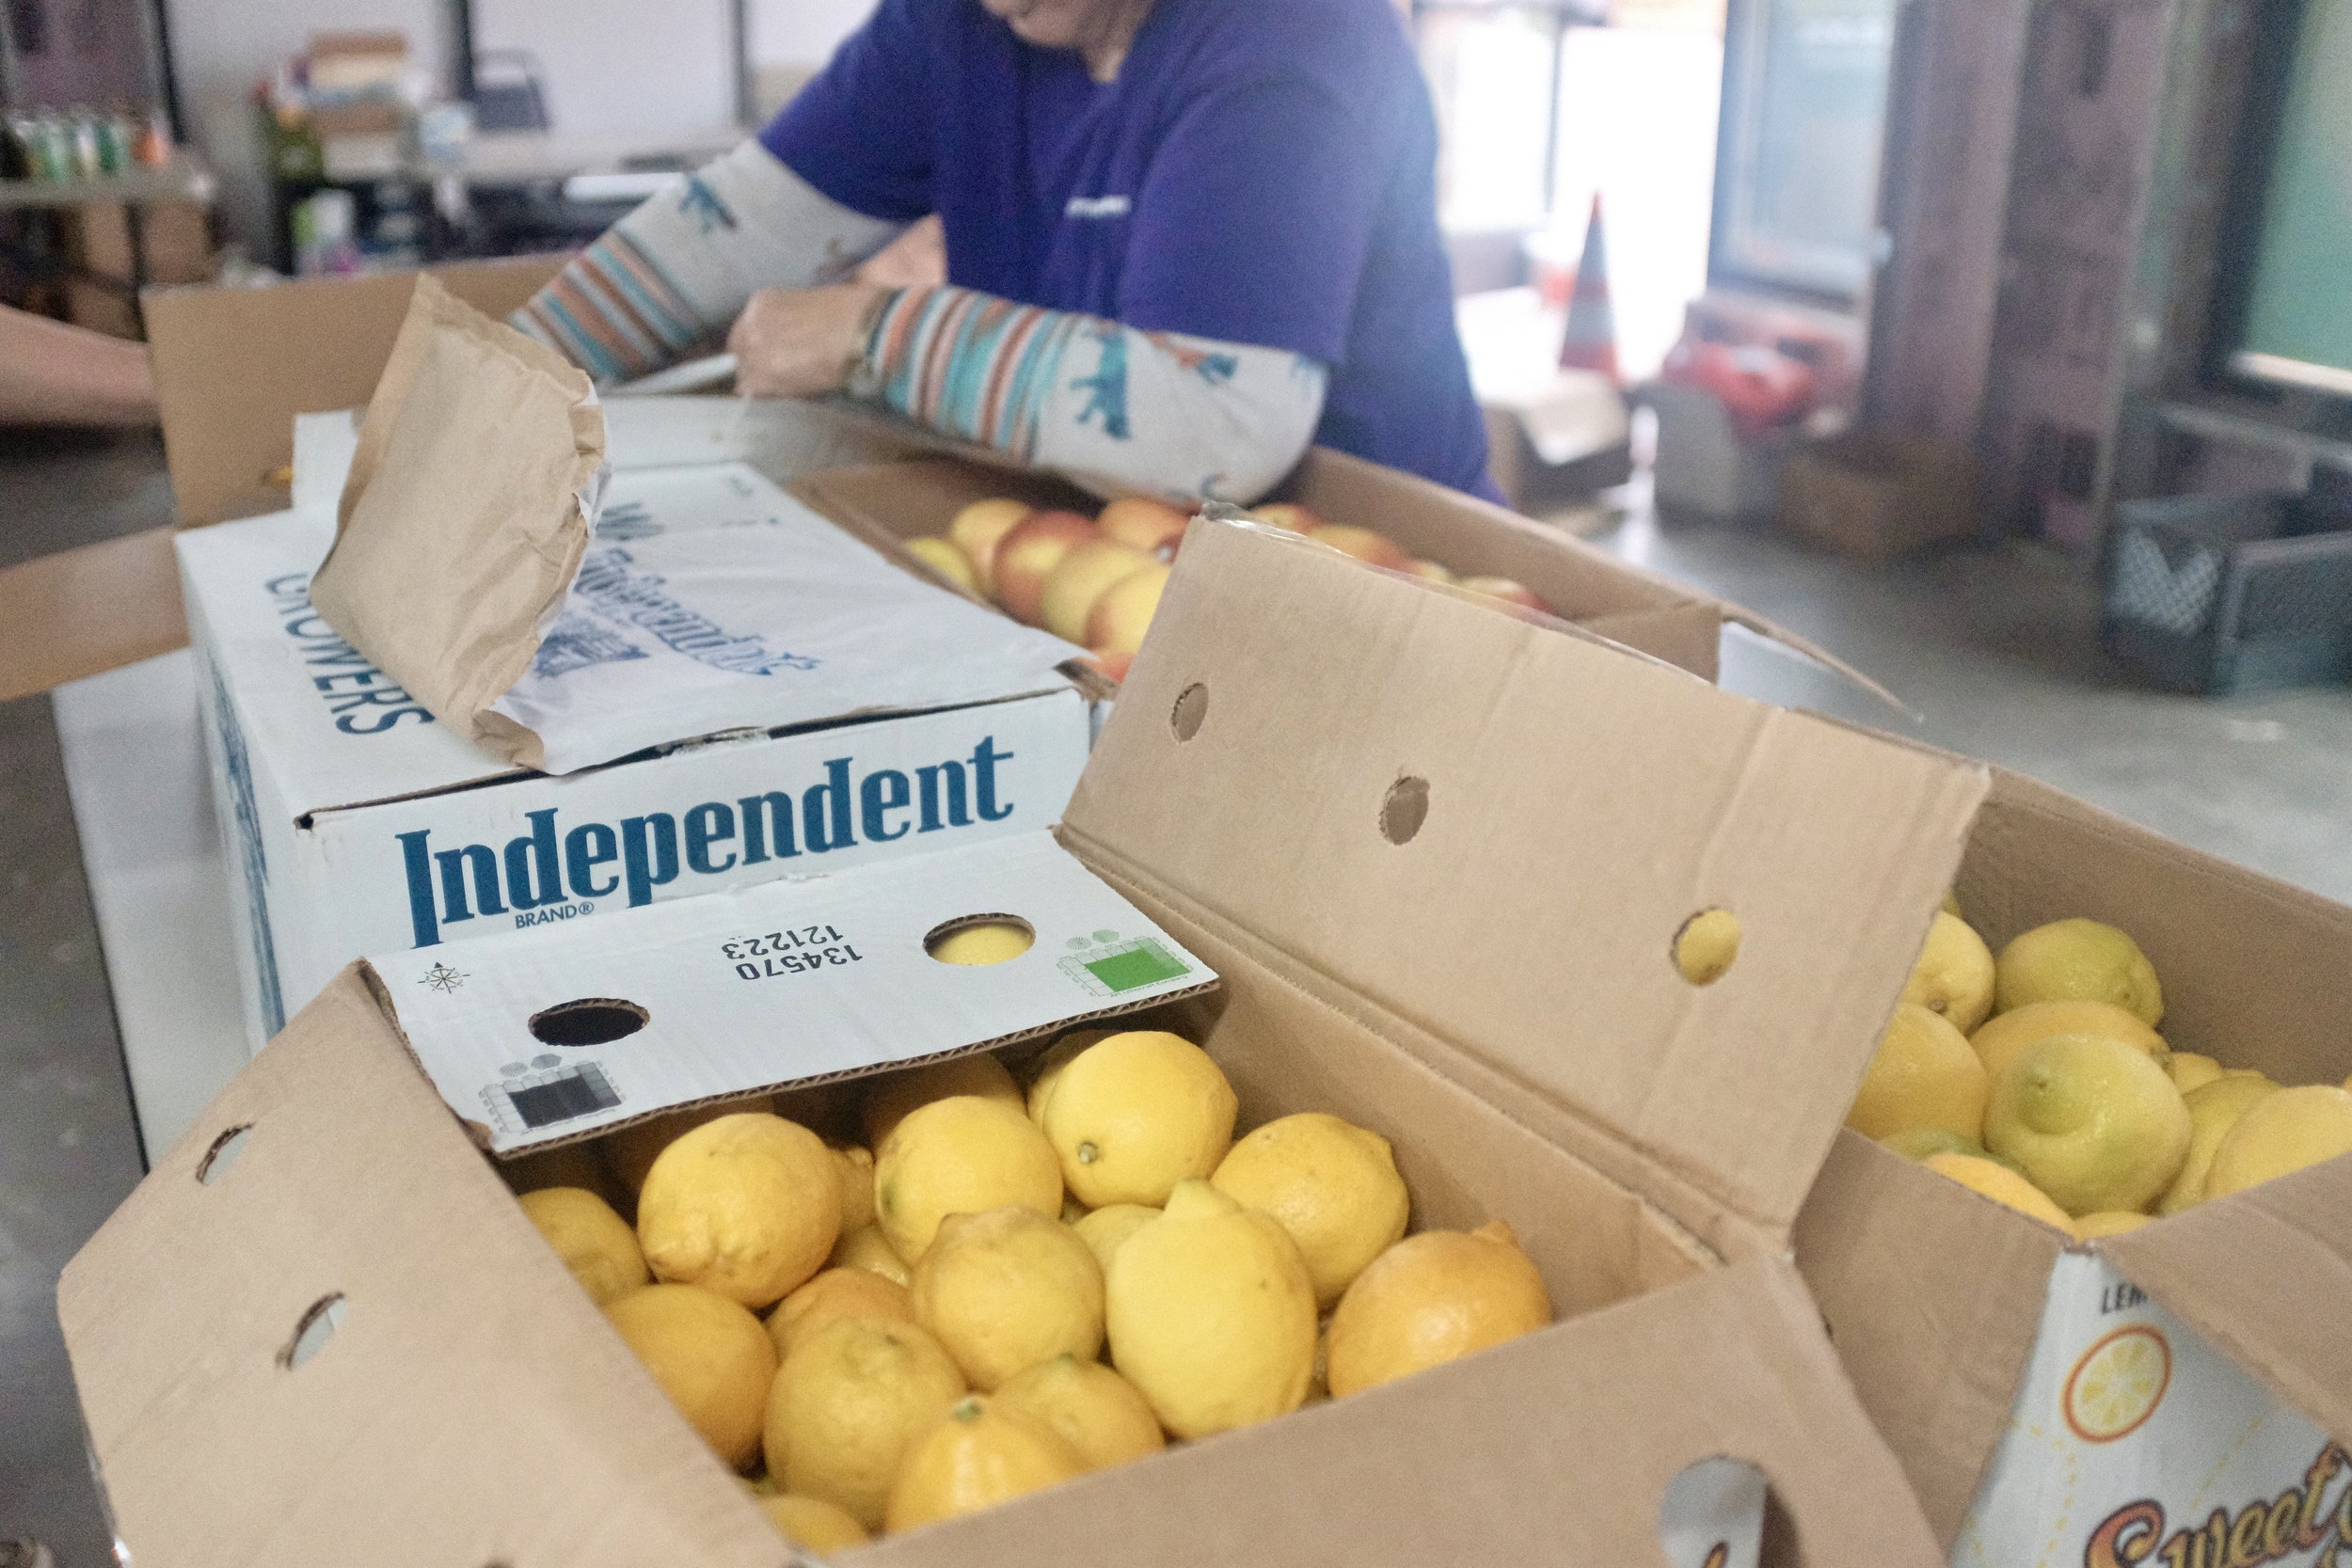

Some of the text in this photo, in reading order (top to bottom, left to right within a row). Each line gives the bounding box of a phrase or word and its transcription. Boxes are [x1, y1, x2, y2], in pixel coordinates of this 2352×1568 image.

[394, 735, 1015, 950] Independent
[721, 925, 844, 959] 121223
[735, 944, 863, 980] 134570
[2101, 1283, 2149, 1315] LEM
[2084, 1442, 2352, 1568] Sweet
